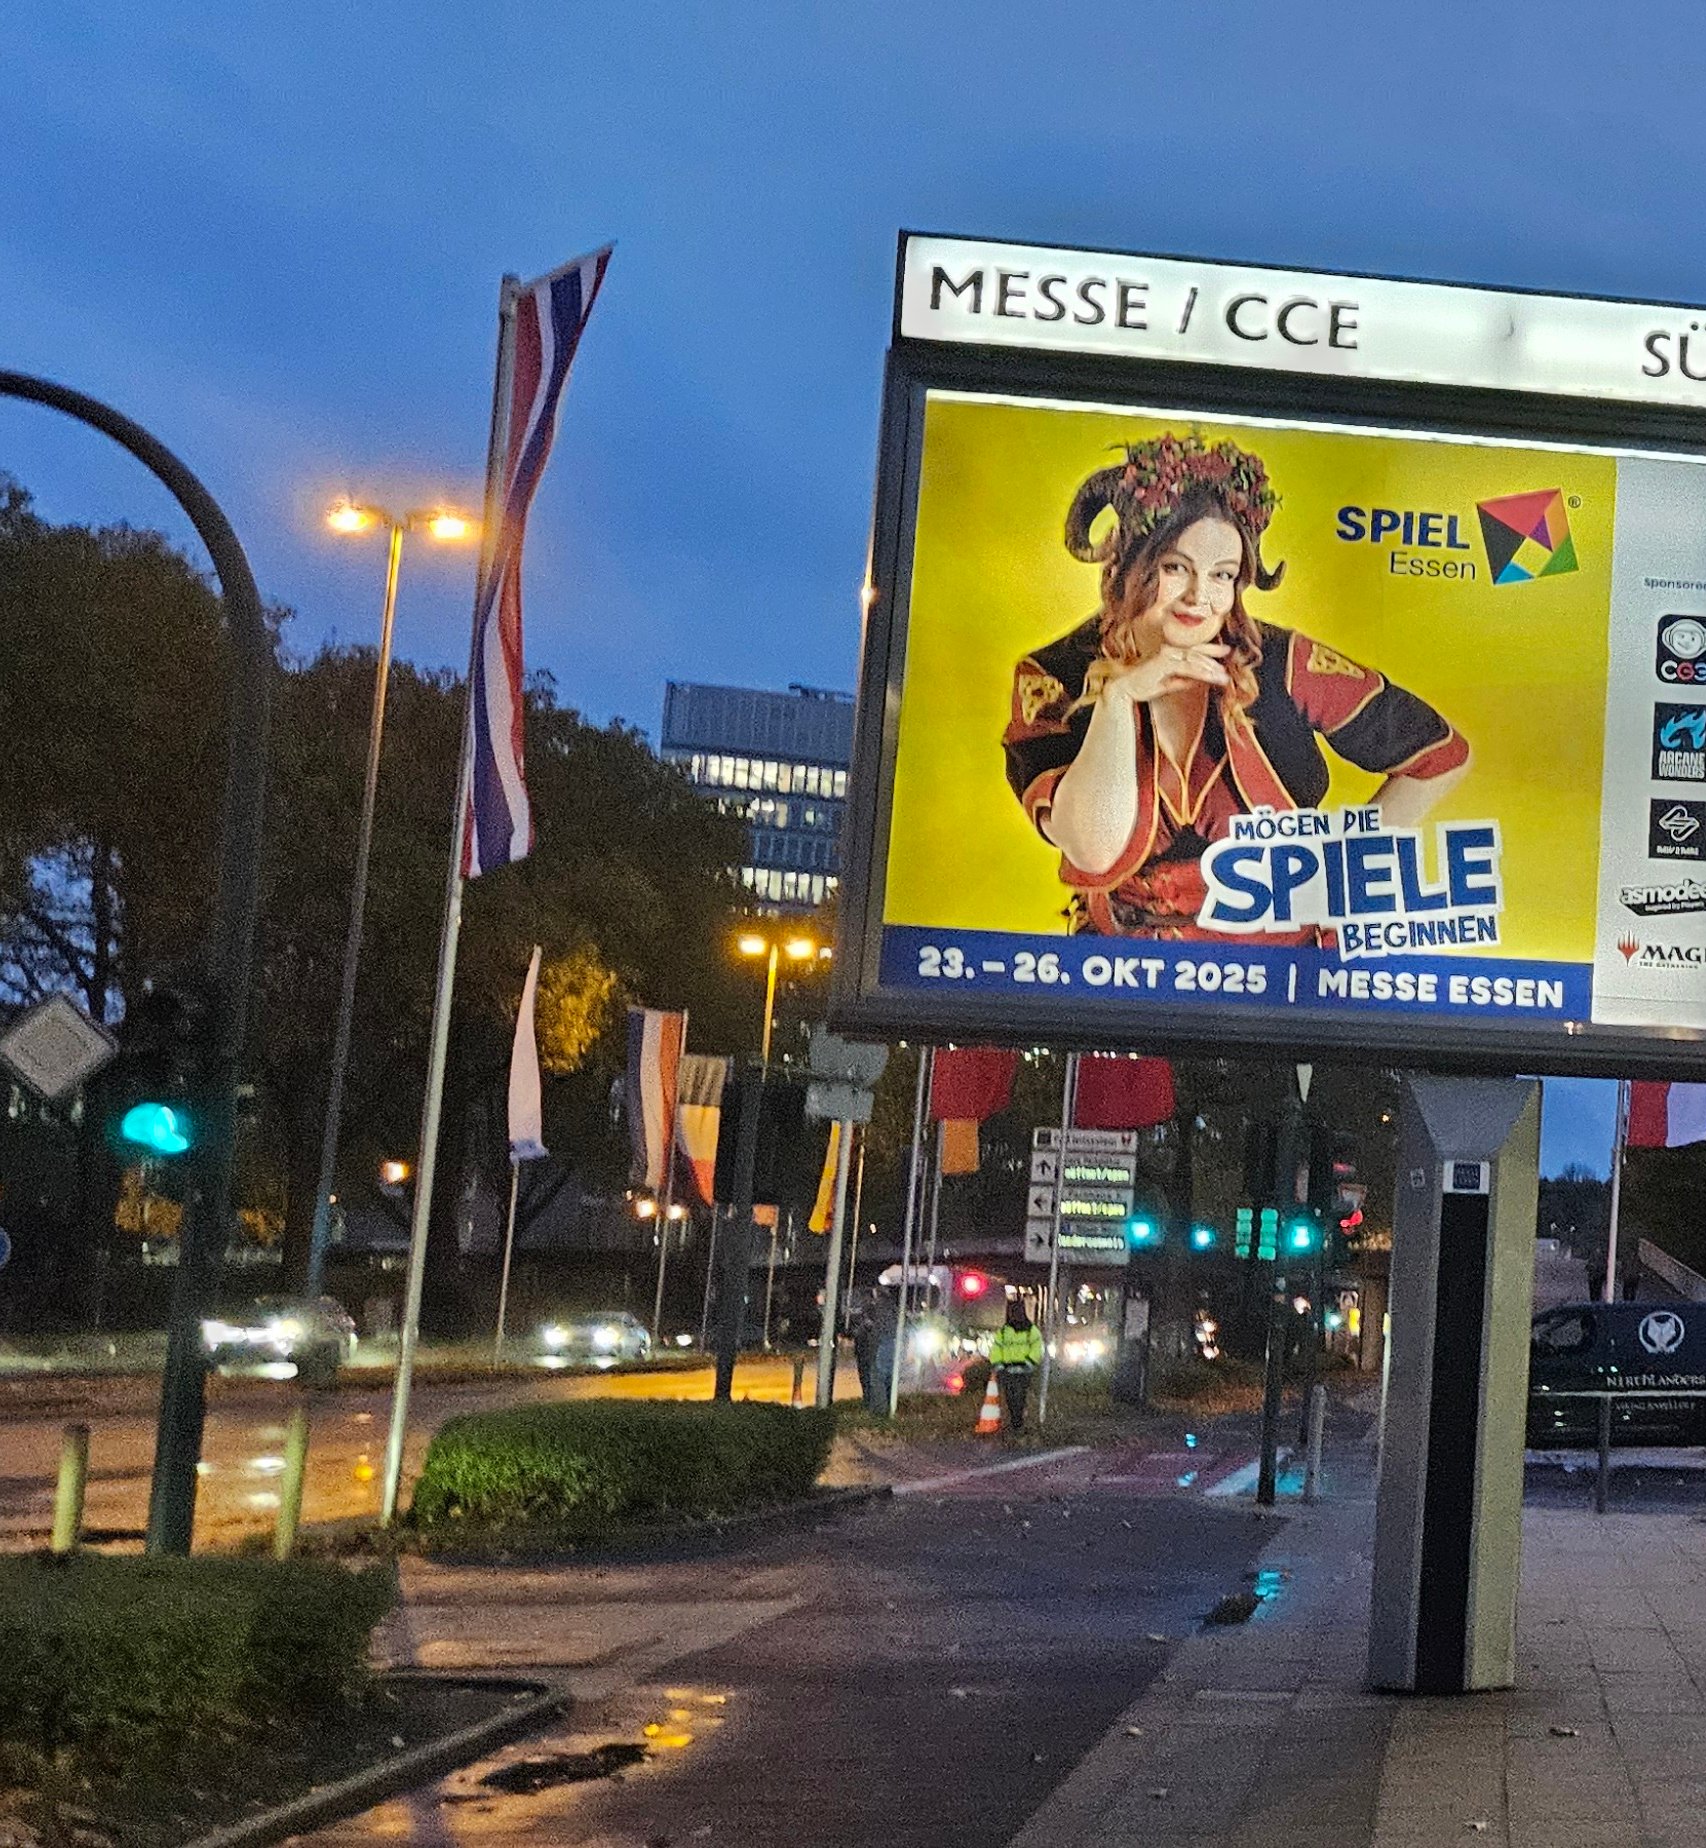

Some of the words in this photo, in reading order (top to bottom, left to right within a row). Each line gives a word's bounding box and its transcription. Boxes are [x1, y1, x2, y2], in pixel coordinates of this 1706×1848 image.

[930, 265, 1149, 331] MESSE
[1177, 285, 1199, 335] /
[1223, 292, 1359, 350] CCE
[1336, 505, 1471, 551] SPIEL
[1389, 551, 1477, 580] Essen
[1659, 750, 1706, 768] ARCANE
[1234, 806, 1331, 840] MÖGEN
[1343, 808, 1381, 833] DIE
[1210, 826, 1499, 923] SPIELE
[1342, 914, 1498, 952] BEGINNEN
[918, 945, 976, 980] 23.
[1013, 952, 1071, 986] 26.
[1082, 955, 1166, 989] OKT
[1174, 960, 1267, 994] 2025
[1318, 967, 1439, 1003] MESSE
[1449, 974, 1564, 1009] ESSEN
